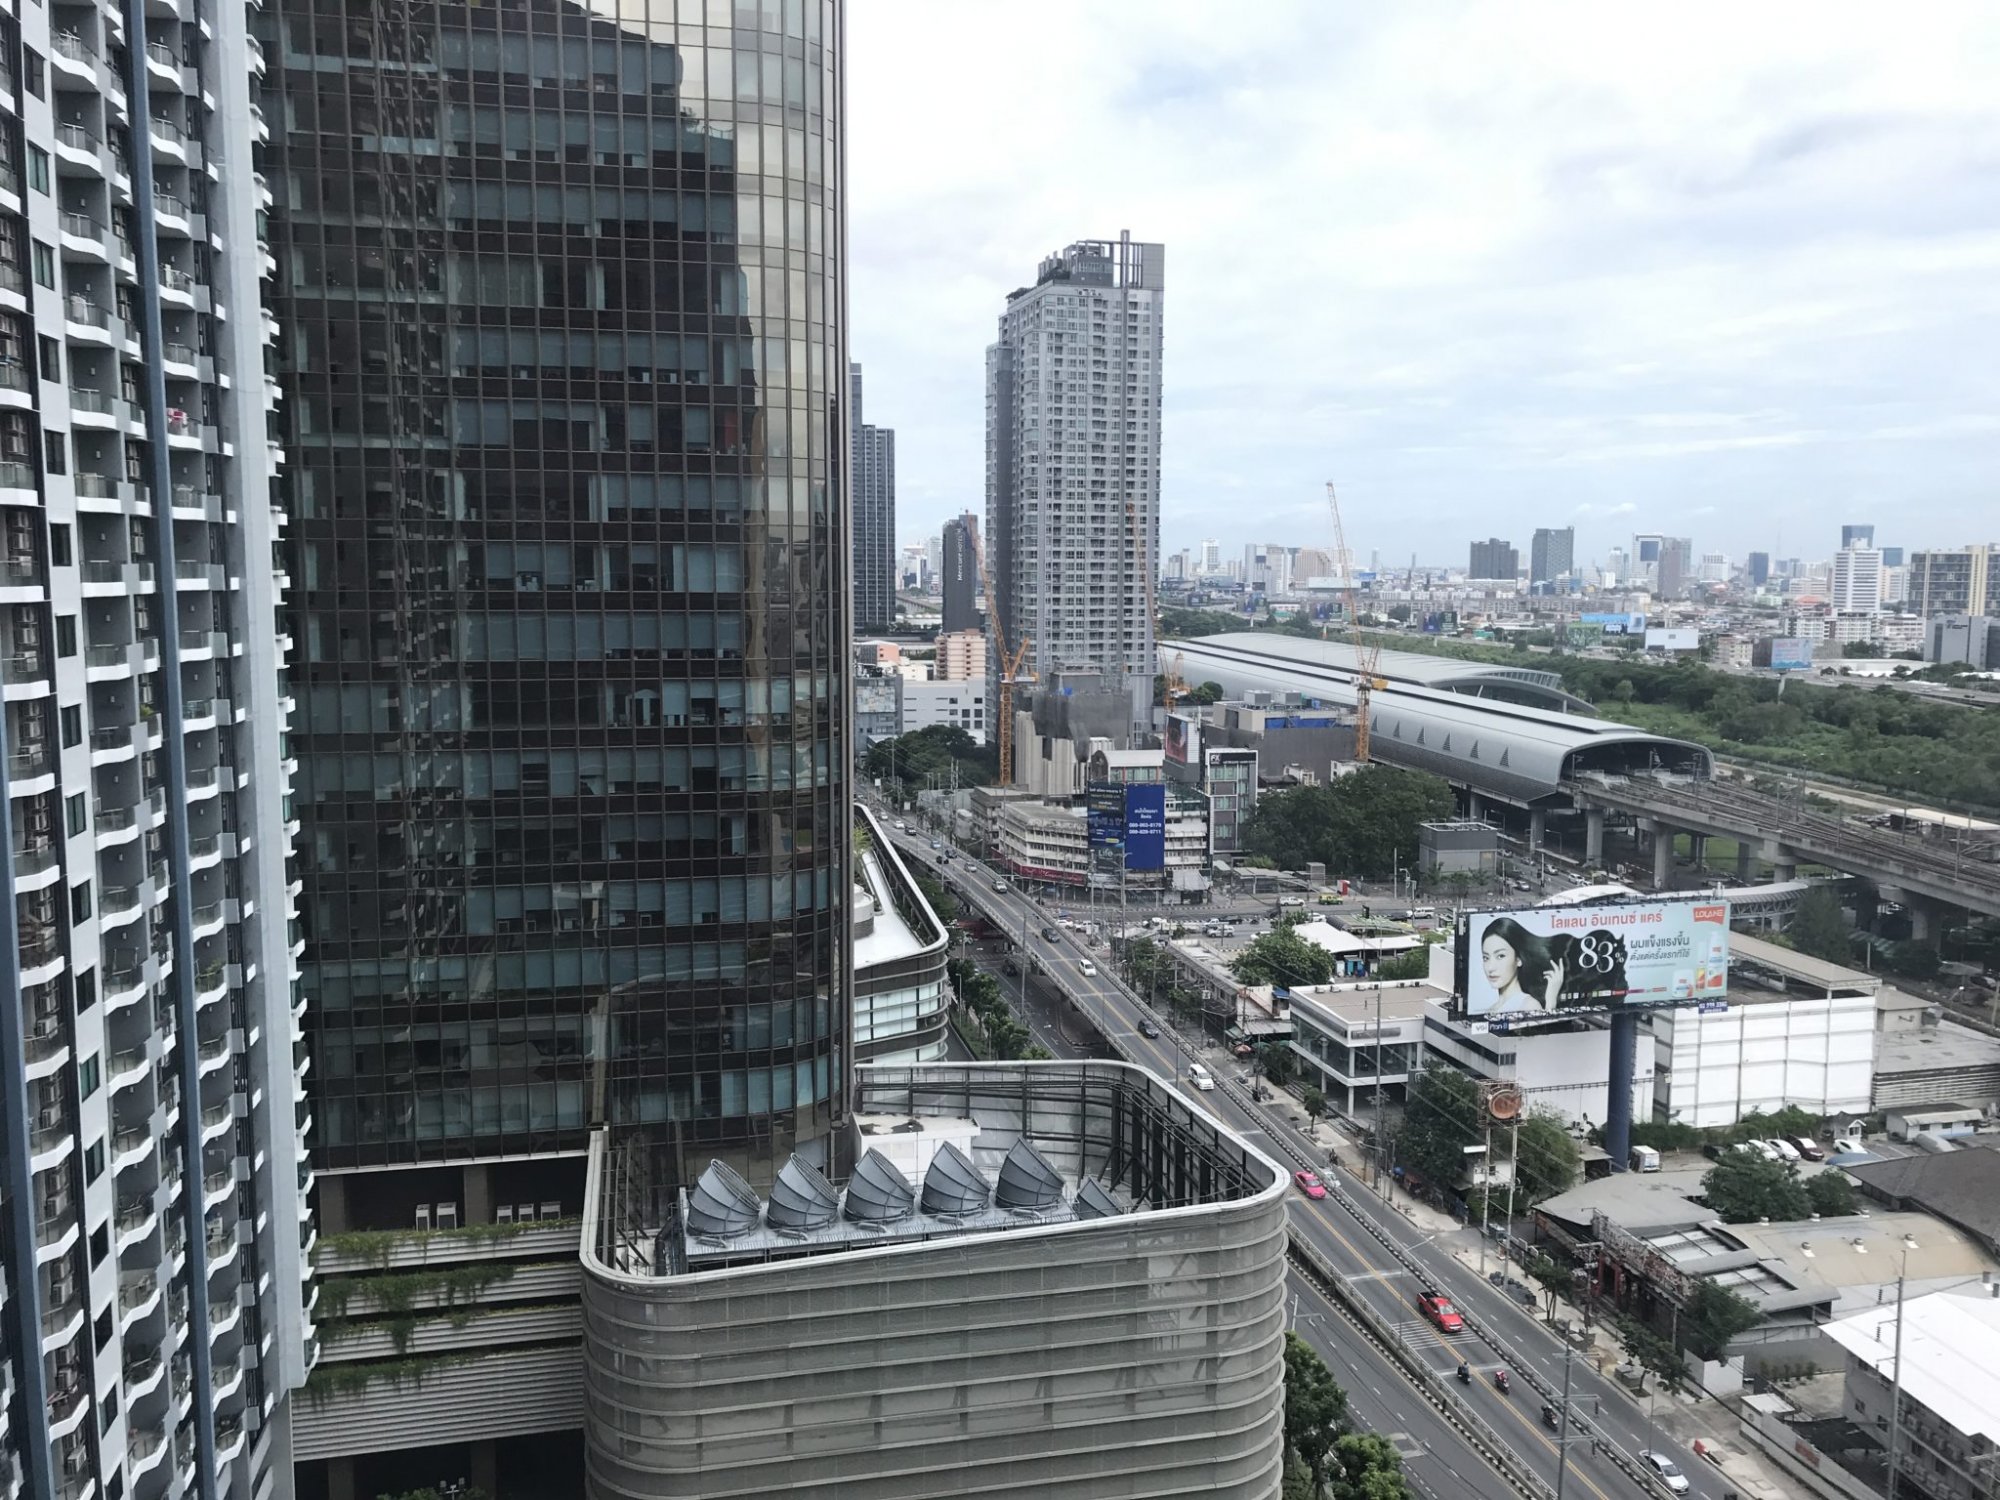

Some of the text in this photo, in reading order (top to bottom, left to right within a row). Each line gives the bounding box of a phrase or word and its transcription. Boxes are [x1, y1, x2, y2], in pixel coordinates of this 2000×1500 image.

[1551, 914, 1587, 929] โลแลน
[1640, 909, 1663, 923] แคร์
[1630, 931, 1690, 949] ผมแข็งแรงขึ้น
